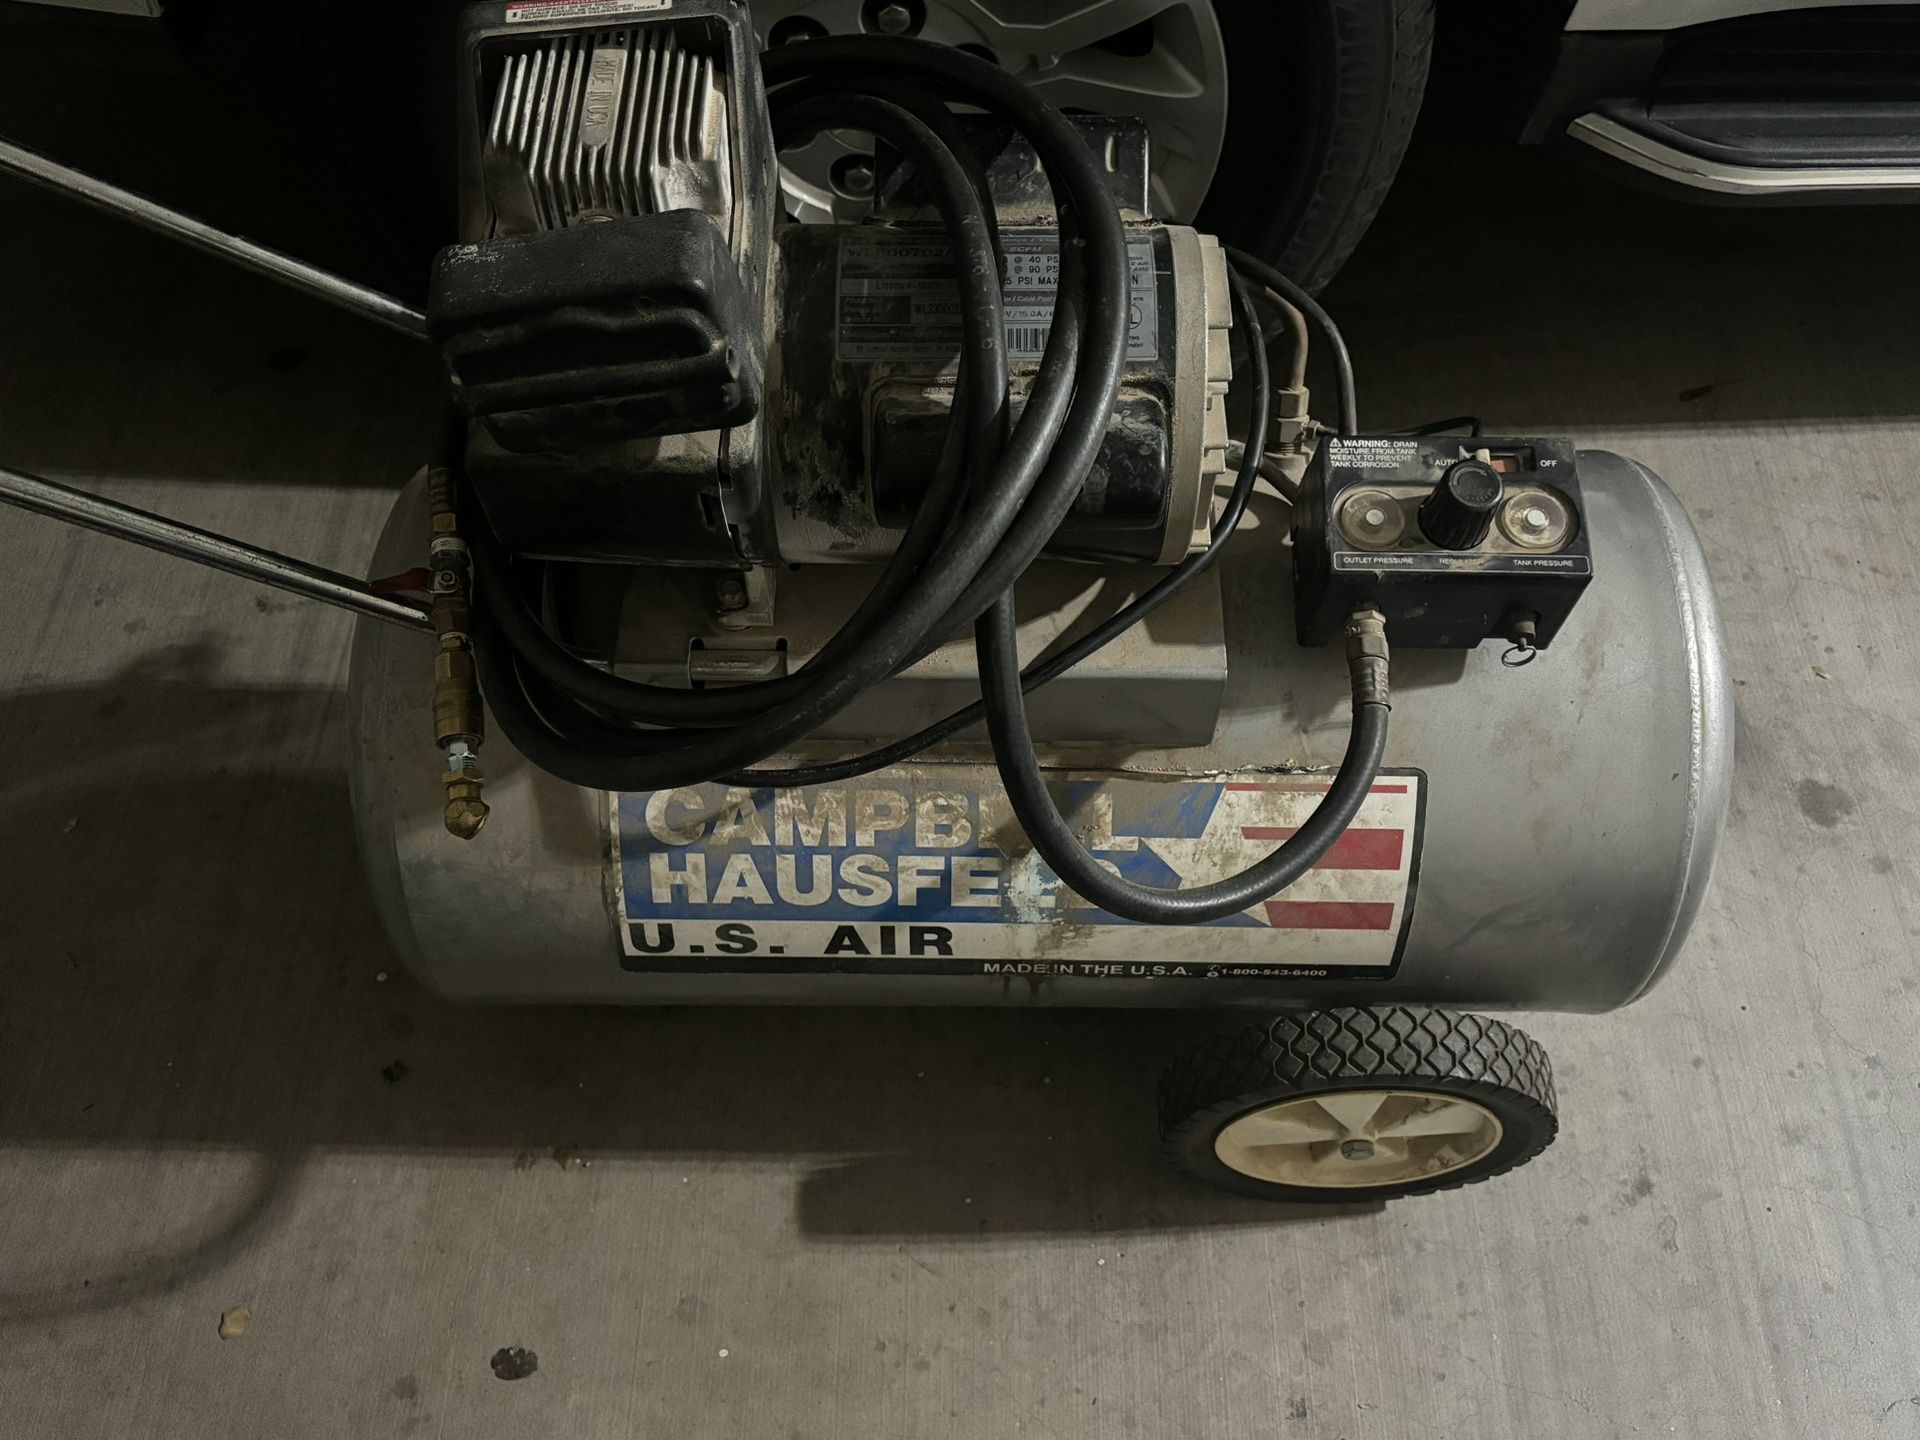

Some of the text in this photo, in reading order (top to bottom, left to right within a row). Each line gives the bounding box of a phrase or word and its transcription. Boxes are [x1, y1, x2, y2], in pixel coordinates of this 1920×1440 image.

[1014, 256, 1023, 264] @
[1018, 277, 1033, 285] PSI
[914, 303, 962, 314] WL330002
[1343, 440, 1392, 448] WARNING:
[1540, 459, 1558, 467] OFF
[1343, 556, 1414, 565] OUTLET PRESSURE
[1513, 559, 1574, 568] TANK PRESSURE
[645, 787, 1139, 850] CAMPBL
[628, 922, 954, 956] U.S. AIR
[984, 963, 1193, 977] MADE IN THE U.S.A.
[1221, 968, 1328, 977] 1-800-543-6400
